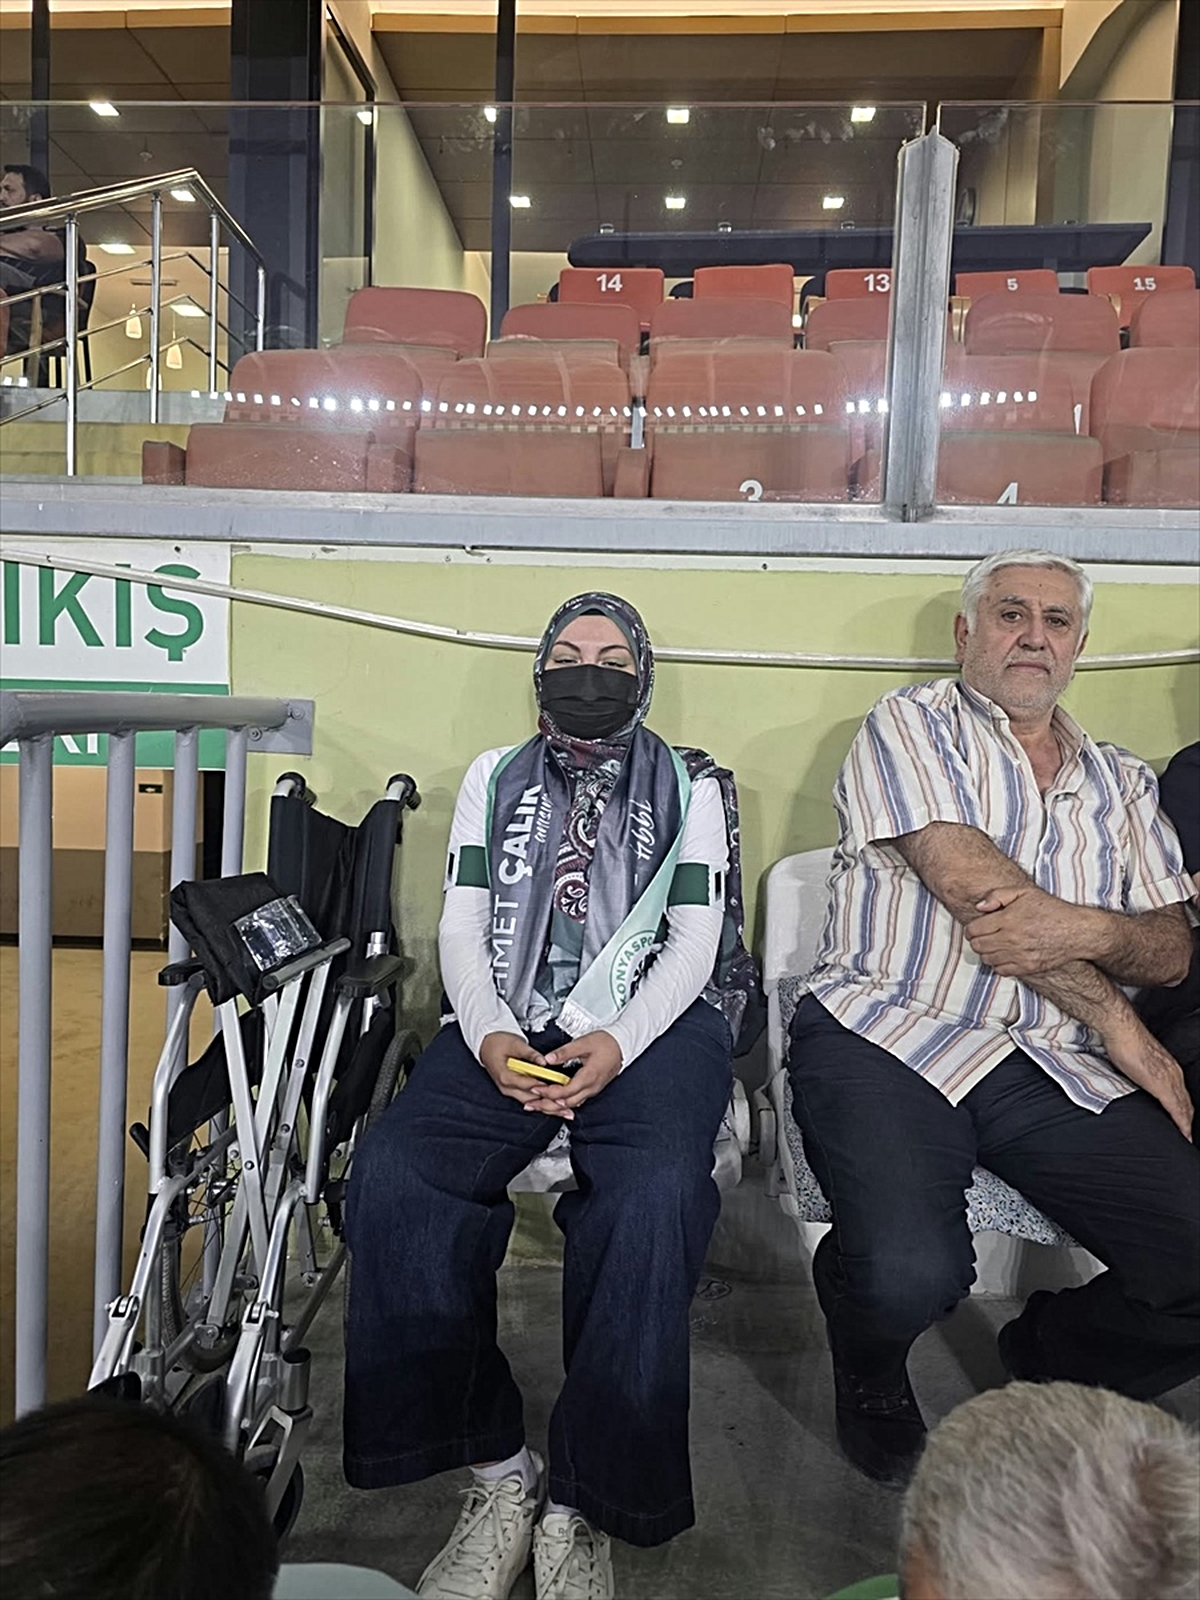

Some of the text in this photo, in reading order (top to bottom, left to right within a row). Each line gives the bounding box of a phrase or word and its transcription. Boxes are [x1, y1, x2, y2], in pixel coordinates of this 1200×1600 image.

[597, 273, 623, 292] 14
[864, 273, 890, 292] 13
[1007, 278, 1019, 291] 5
[1133, 277, 1156, 291] 15
[629, 799, 655, 861] 1994
